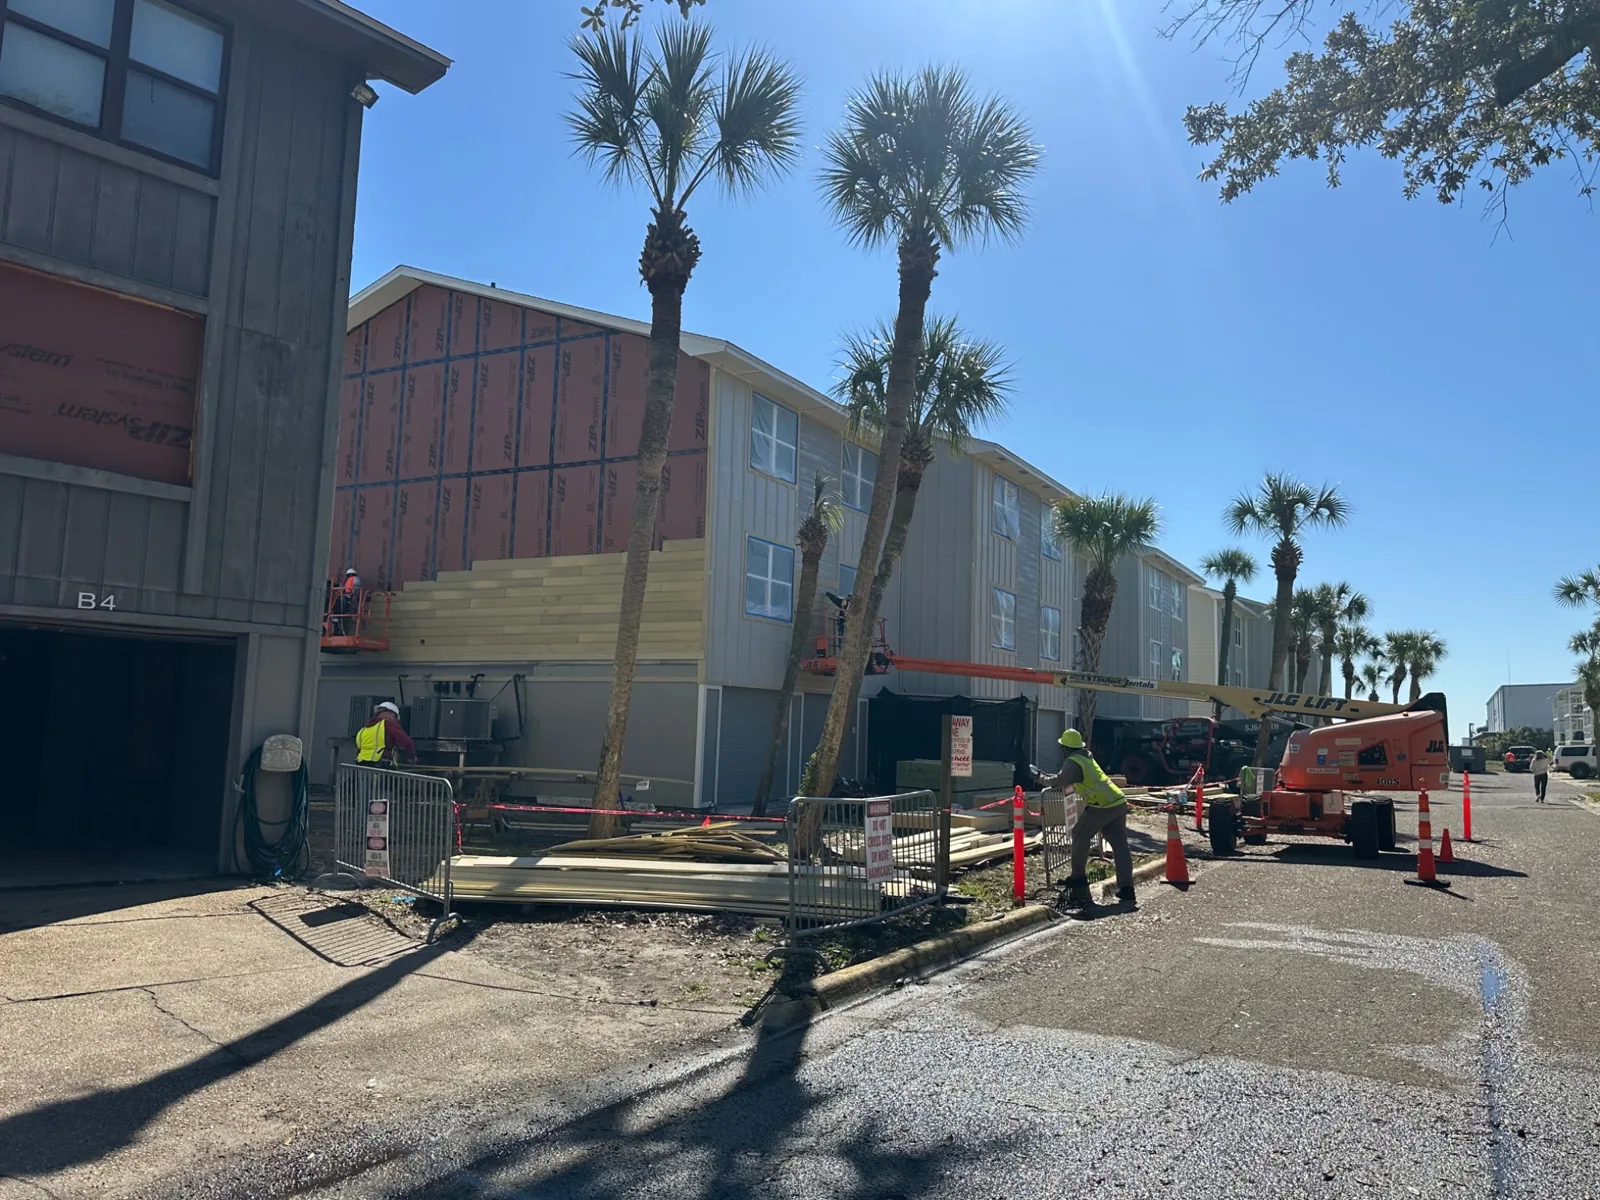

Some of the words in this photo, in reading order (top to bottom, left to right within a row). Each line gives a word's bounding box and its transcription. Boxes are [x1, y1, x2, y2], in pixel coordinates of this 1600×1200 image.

[77, 591, 116, 611] B4
[1263, 692, 1300, 706] JLG
[1303, 696, 1348, 711] LIFT
[1425, 739, 1444, 753] JLG
[1375, 778, 1400, 786] 400S
[872, 820, 878, 832] DO
[879, 819, 887, 831] NOT
[868, 835, 881, 847] CROSS
[878, 850, 889, 862] MOVE
[868, 864, 893, 880] BARRICADES
